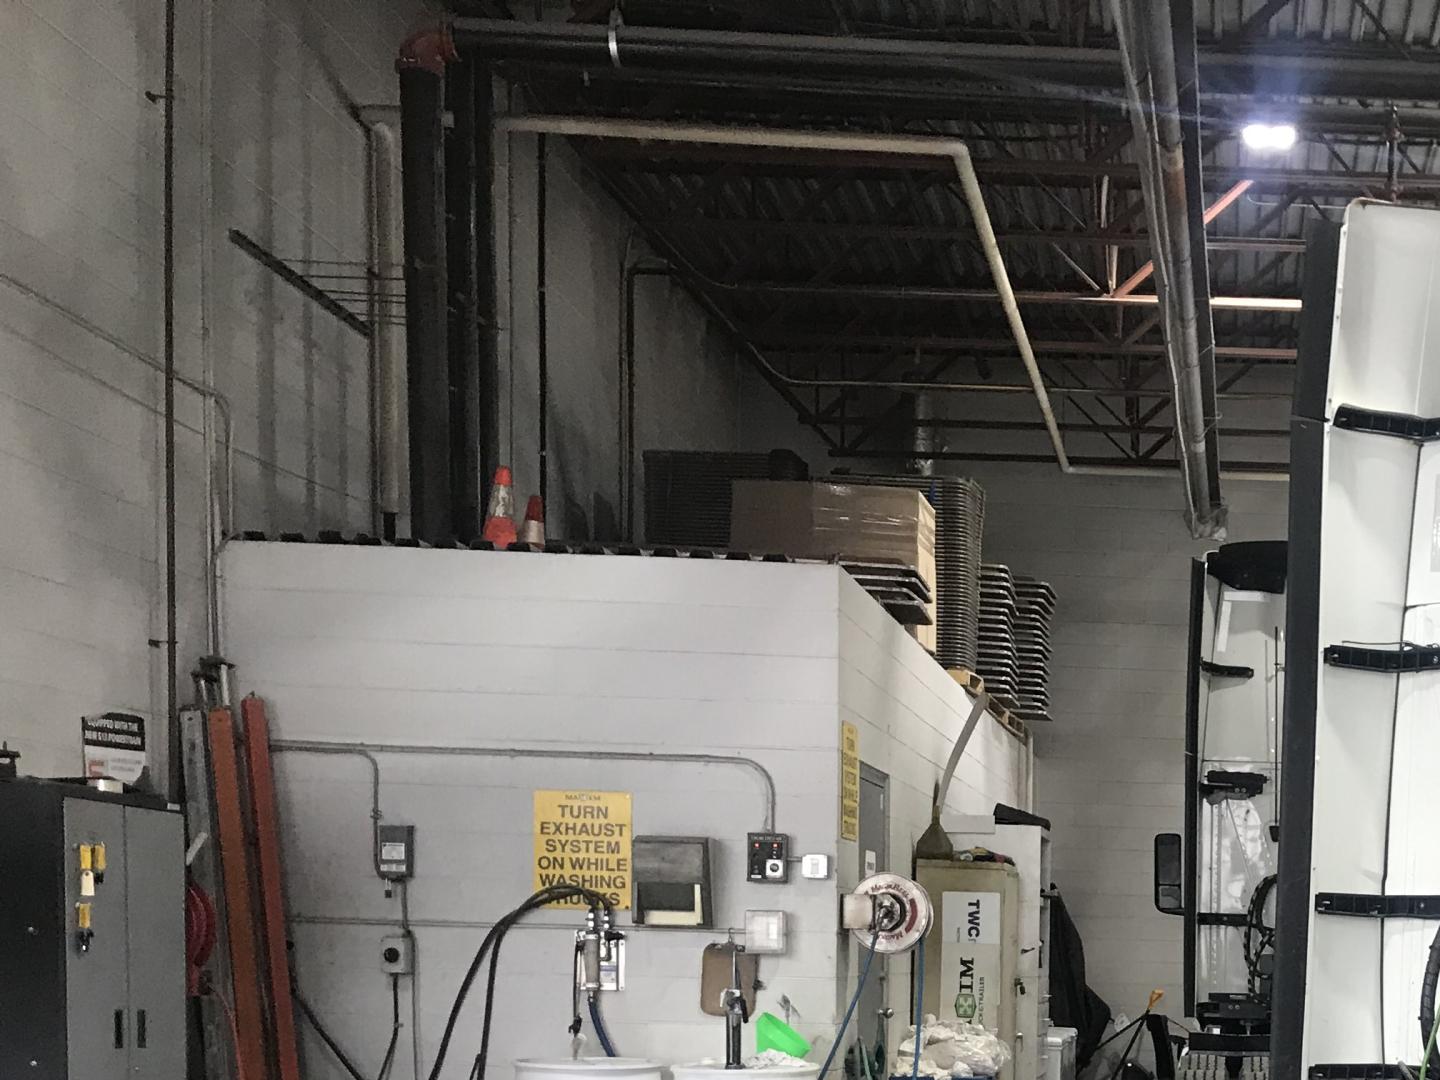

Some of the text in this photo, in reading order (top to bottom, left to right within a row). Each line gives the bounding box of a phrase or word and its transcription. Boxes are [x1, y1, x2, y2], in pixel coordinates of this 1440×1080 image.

[558, 804, 609, 820] TURN
[540, 821, 627, 838] EXHAUST
[545, 838, 620, 855] SYSTEM
[538, 856, 628, 873] ON WHILE
[540, 873, 627, 891] WASHING
[967, 898, 981, 939] TWC
